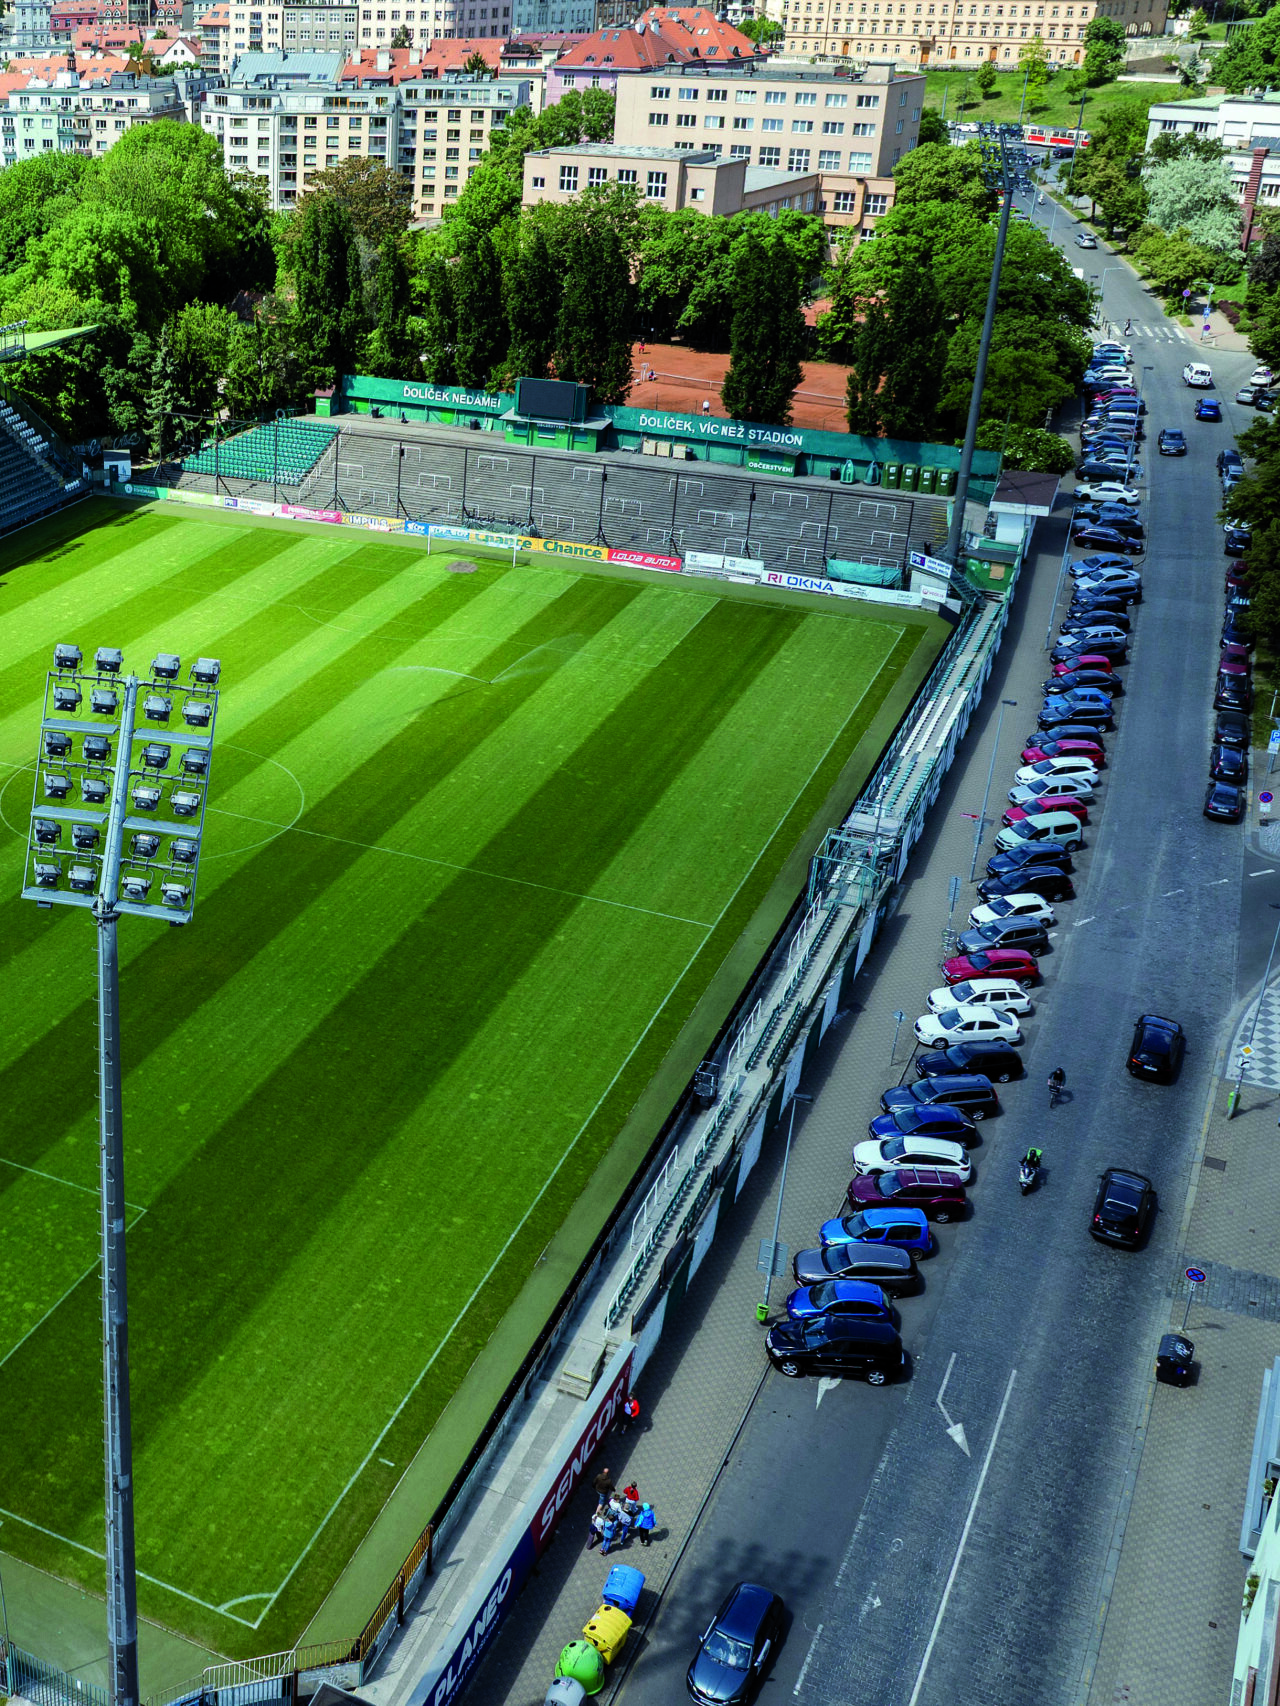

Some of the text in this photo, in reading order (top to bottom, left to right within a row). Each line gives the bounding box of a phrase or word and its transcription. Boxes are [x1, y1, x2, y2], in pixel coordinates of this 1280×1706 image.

[403, 385, 449, 402] ĎOLÍČEK
[639, 413, 803, 446] ĎOLÍČEK, VÍC NEŽ STADION
[348, 514, 388, 527] IMPULS
[543, 540, 602, 559] Chance
[767, 573, 834, 592] RI OKNA
[540, 1378, 624, 1541] SENCOR
[434, 1567, 512, 1706] PLANEO
